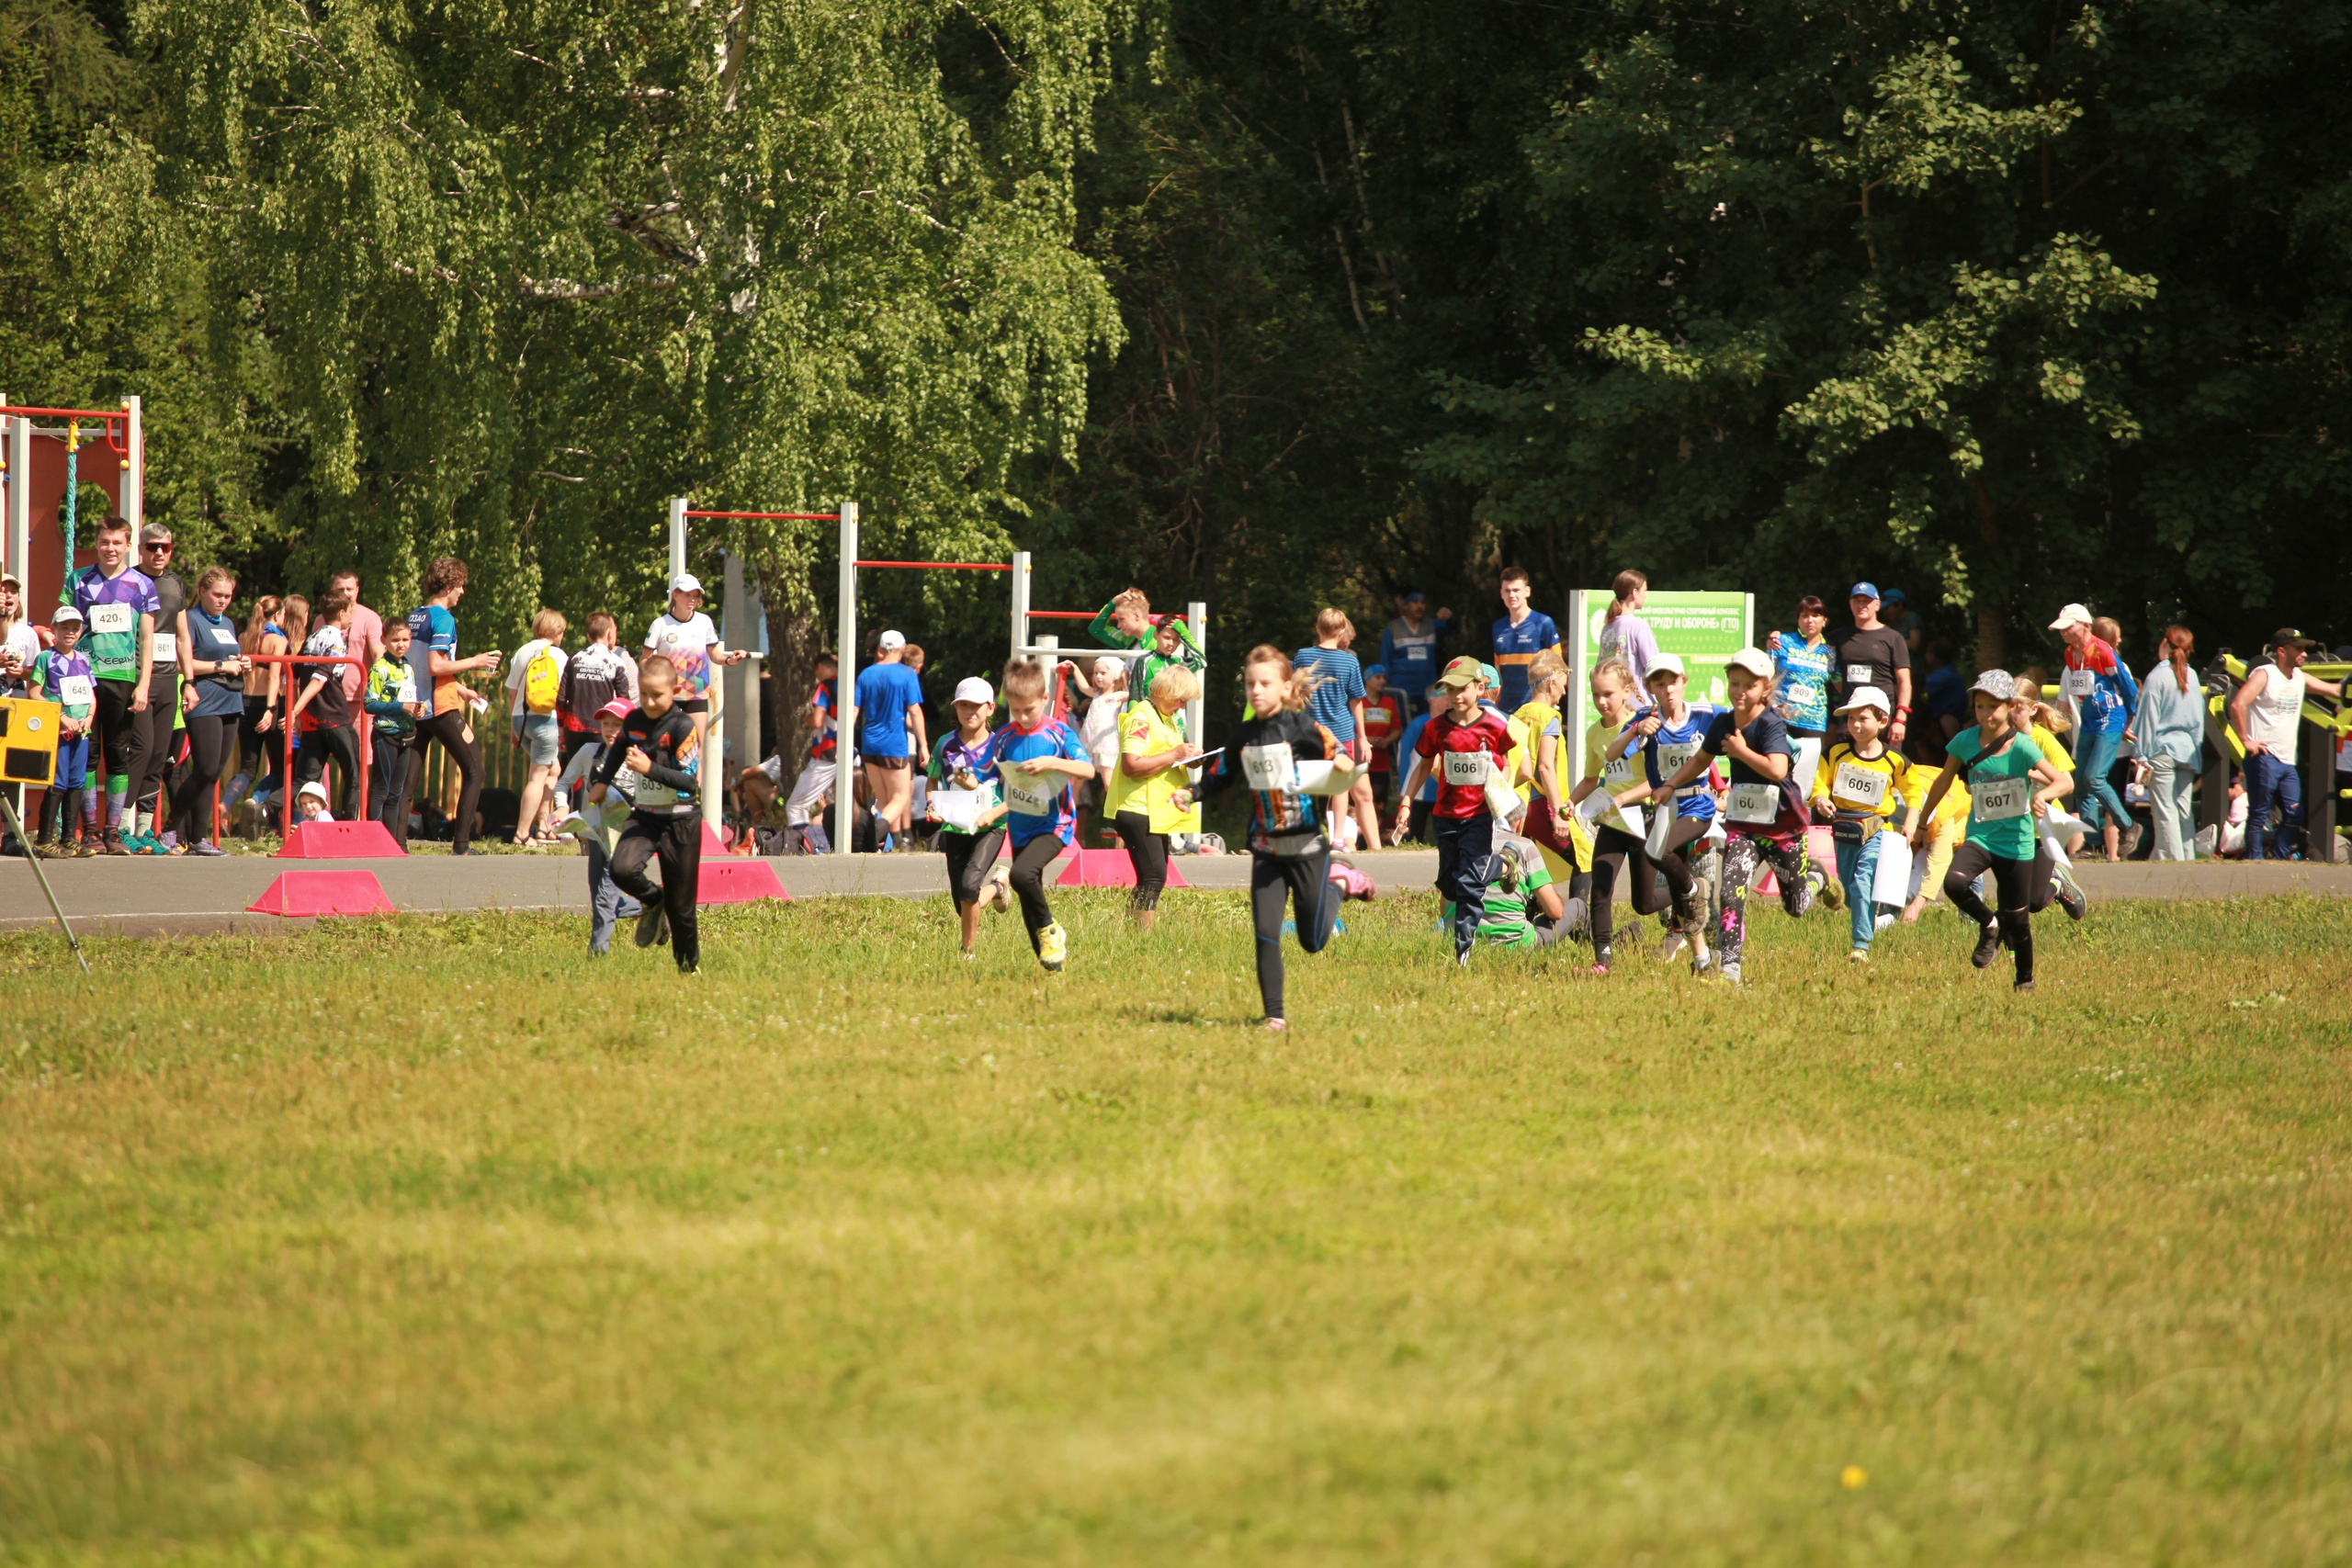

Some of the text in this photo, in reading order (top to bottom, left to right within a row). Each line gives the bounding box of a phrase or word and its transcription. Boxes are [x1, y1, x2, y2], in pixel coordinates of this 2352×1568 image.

[99, 613, 119, 624] 420
[1650, 617, 1673, 629] ТРУДУ
[1675, 617, 1680, 628] И
[1721, 617, 1739, 632] (ГТО)
[157, 643, 170, 652] 801
[1850, 667, 1866, 675] 832
[72, 685, 87, 695] 645
[1793, 687, 1810, 697] 909
[1252, 760, 1274, 773] 613
[1453, 762, 1477, 773] 606
[1605, 760, 1623, 774] 611
[641, 778, 662, 791] 603
[1849, 778, 1871, 793] 605
[1012, 787, 1033, 804] 602
[1984, 793, 2011, 808] 607
